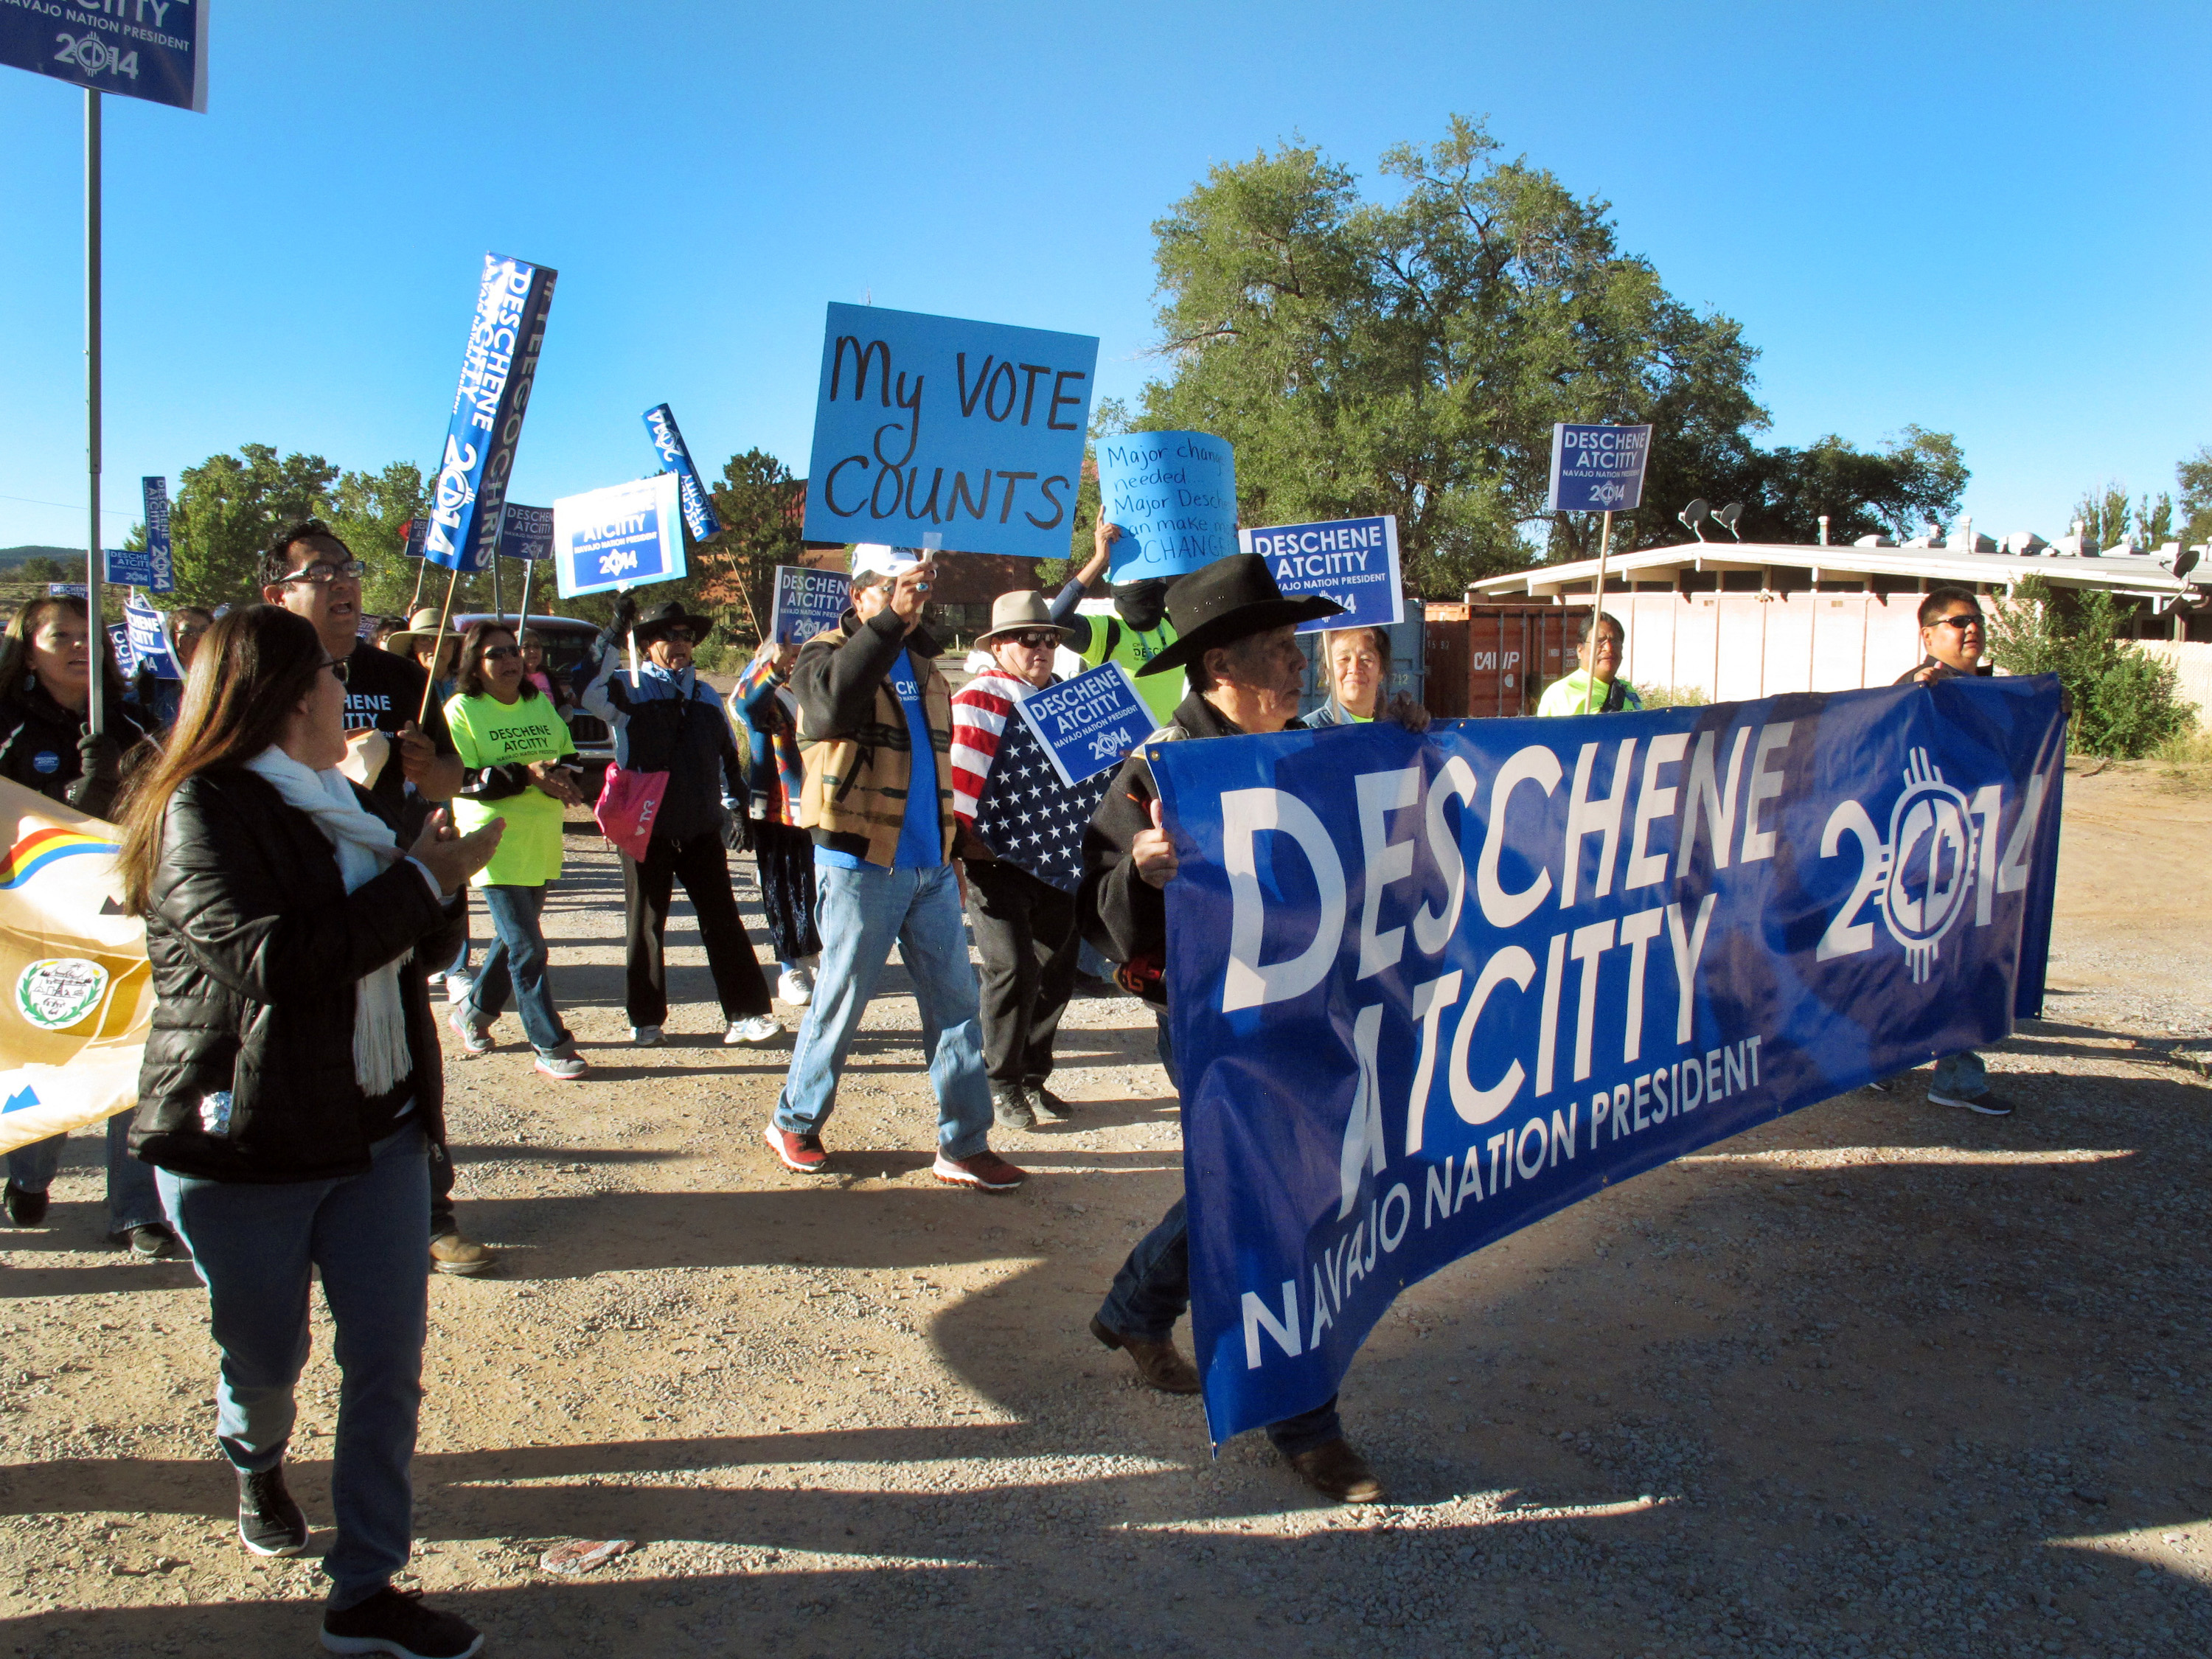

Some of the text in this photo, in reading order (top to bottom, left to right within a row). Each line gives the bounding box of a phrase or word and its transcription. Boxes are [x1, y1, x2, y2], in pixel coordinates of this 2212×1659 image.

[66, 10, 120, 34] NATION
[123, 24, 190, 52] PRESIDENT
[55, 32, 139, 80] 2014
[465, 315, 481, 358] NATION
[471, 268, 532, 433] DESCHENE
[830, 335, 1086, 468] My VOTE
[647, 408, 685, 462] 2014
[1564, 431, 1646, 451] DESCHENE
[1107, 445, 1168, 470] Major
[1562, 470, 1594, 478] NAVAJO
[1596, 470, 1620, 479] NATION
[1576, 451, 1638, 469] ATCITTY
[148, 488, 160, 531] ATCITTY
[157, 480, 170, 539] DESCHENE
[427, 434, 478, 557] 2014
[825, 455, 1071, 530] COUNTS
[1114, 495, 1170, 517] Major
[1588, 483, 1625, 502] 2014
[583, 513, 646, 543] ATCITTY
[1158, 518, 1208, 532] make
[1255, 526, 1382, 557] DESCHENE
[574, 542, 601, 554] NAVAJO
[599, 549, 638, 574] 2014
[1276, 550, 1368, 580] ATCITTY
[152, 545, 170, 590] 2014
[1304, 577, 1339, 588] NATION
[1342, 573, 1385, 585] PRESIDENT
[787, 591, 845, 611] ATCITTY
[1029, 669, 1121, 722] DESCHENE
[1057, 690, 1121, 734] ATCITTY
[489, 725, 552, 741] DESCHENE
[504, 737, 549, 753] ATCITTY
[1053, 704, 1138, 748] NAVAJO NATION PRESIDENT
[1088, 726, 1132, 760] 2014
[639, 800, 655, 822] TYR
[1220, 720, 1795, 1014] DESCHENE
[1815, 773, 2044, 963] 2014
[1336, 893, 1718, 1222] ATCITTY
[1241, 1034, 1763, 1370] NAVAJO NATION PRESIDENT
